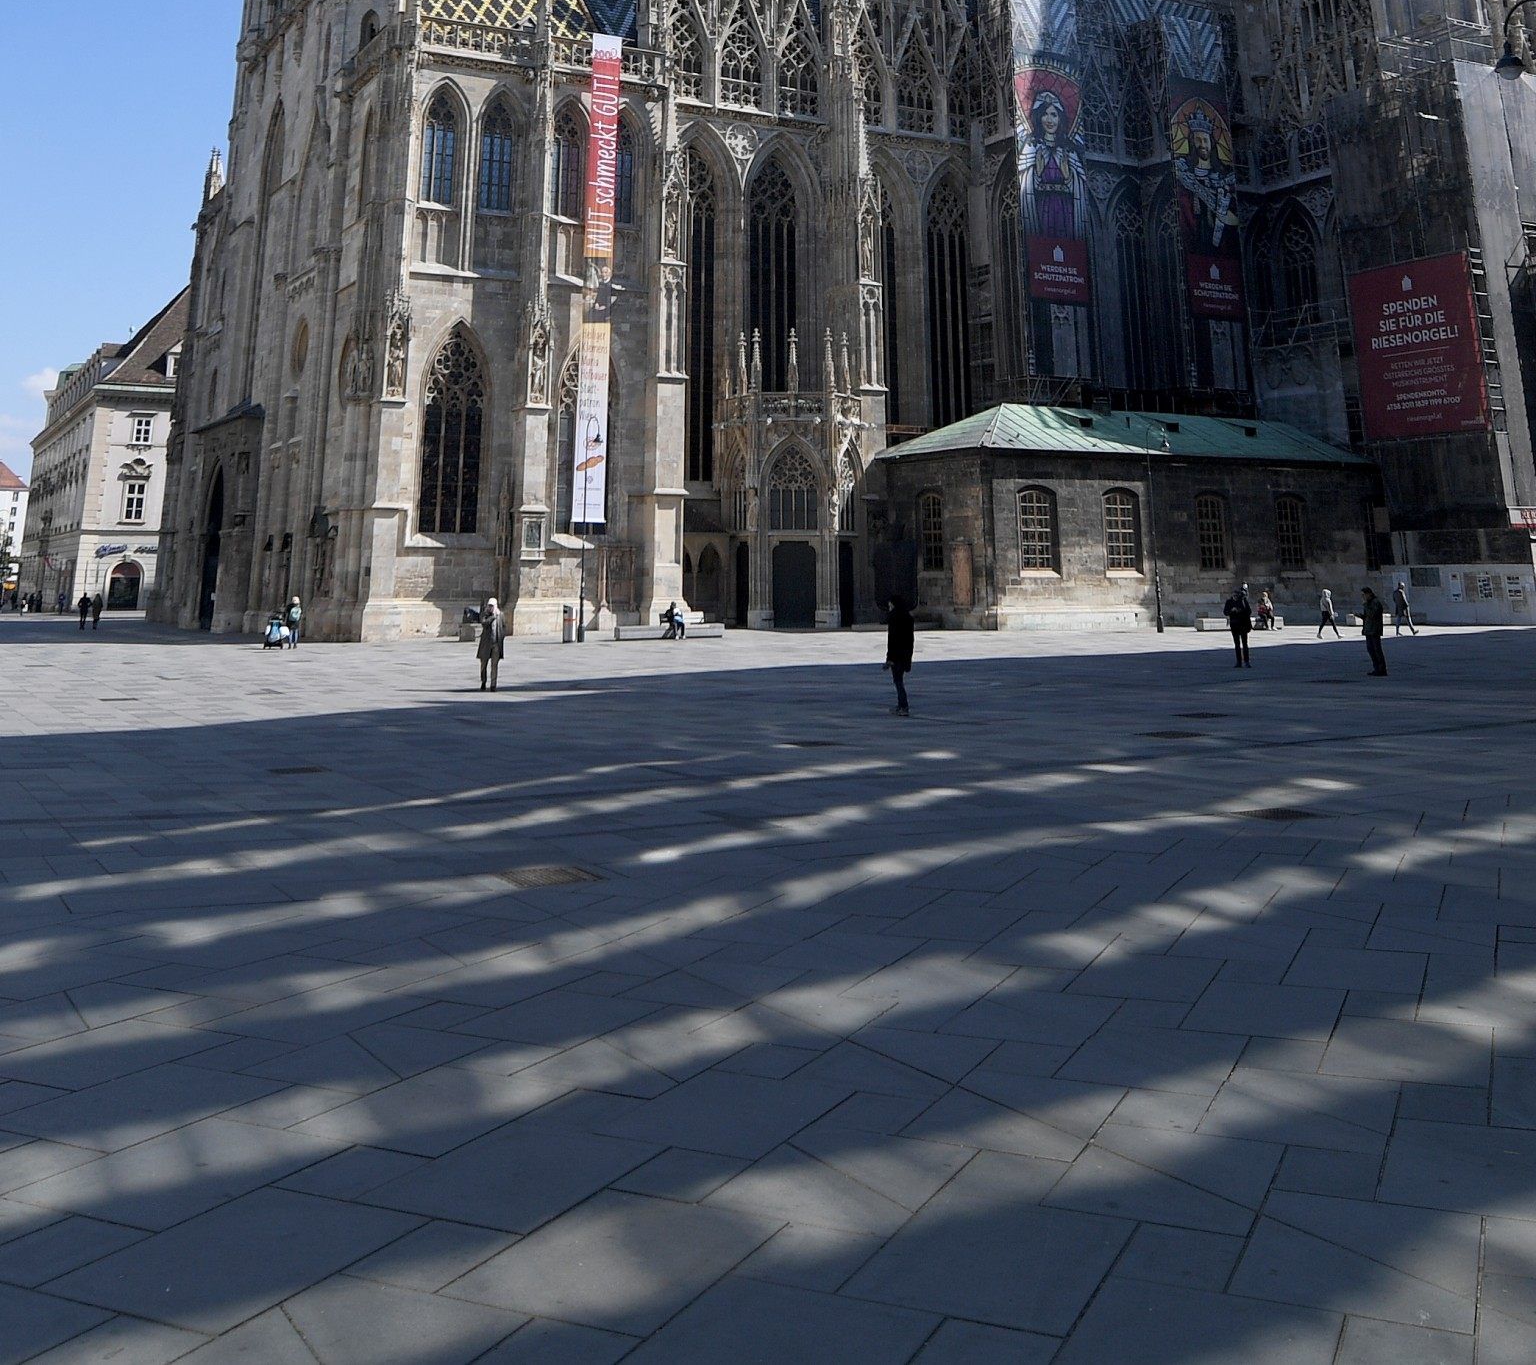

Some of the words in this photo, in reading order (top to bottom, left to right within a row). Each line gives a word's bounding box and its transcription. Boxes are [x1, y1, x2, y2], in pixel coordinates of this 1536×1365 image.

[592, 74, 619, 116] GUT!
[588, 120, 618, 207] schmeckt
[586, 207, 614, 252] MUT
[1040, 263, 1067, 273] WERDEN
[1068, 267, 1078, 275] SIE
[1199, 282, 1223, 291] WERDEN
[1382, 295, 1438, 316] SPENDEN
[1379, 318, 1397, 332] SIE
[1399, 312, 1422, 329] FÜR
[1425, 310, 1446, 325] DIE
[1371, 324, 1460, 350] RIESENORGEL!
[1423, 364, 1455, 375] GRÖSSTES
[1426, 356, 1443, 365] JETZT
[1401, 401, 1414, 410] 2011
[1415, 399, 1429, 408] 1839
[1429, 398, 1443, 406] 1199
[1443, 396, 1461, 404] 6700
